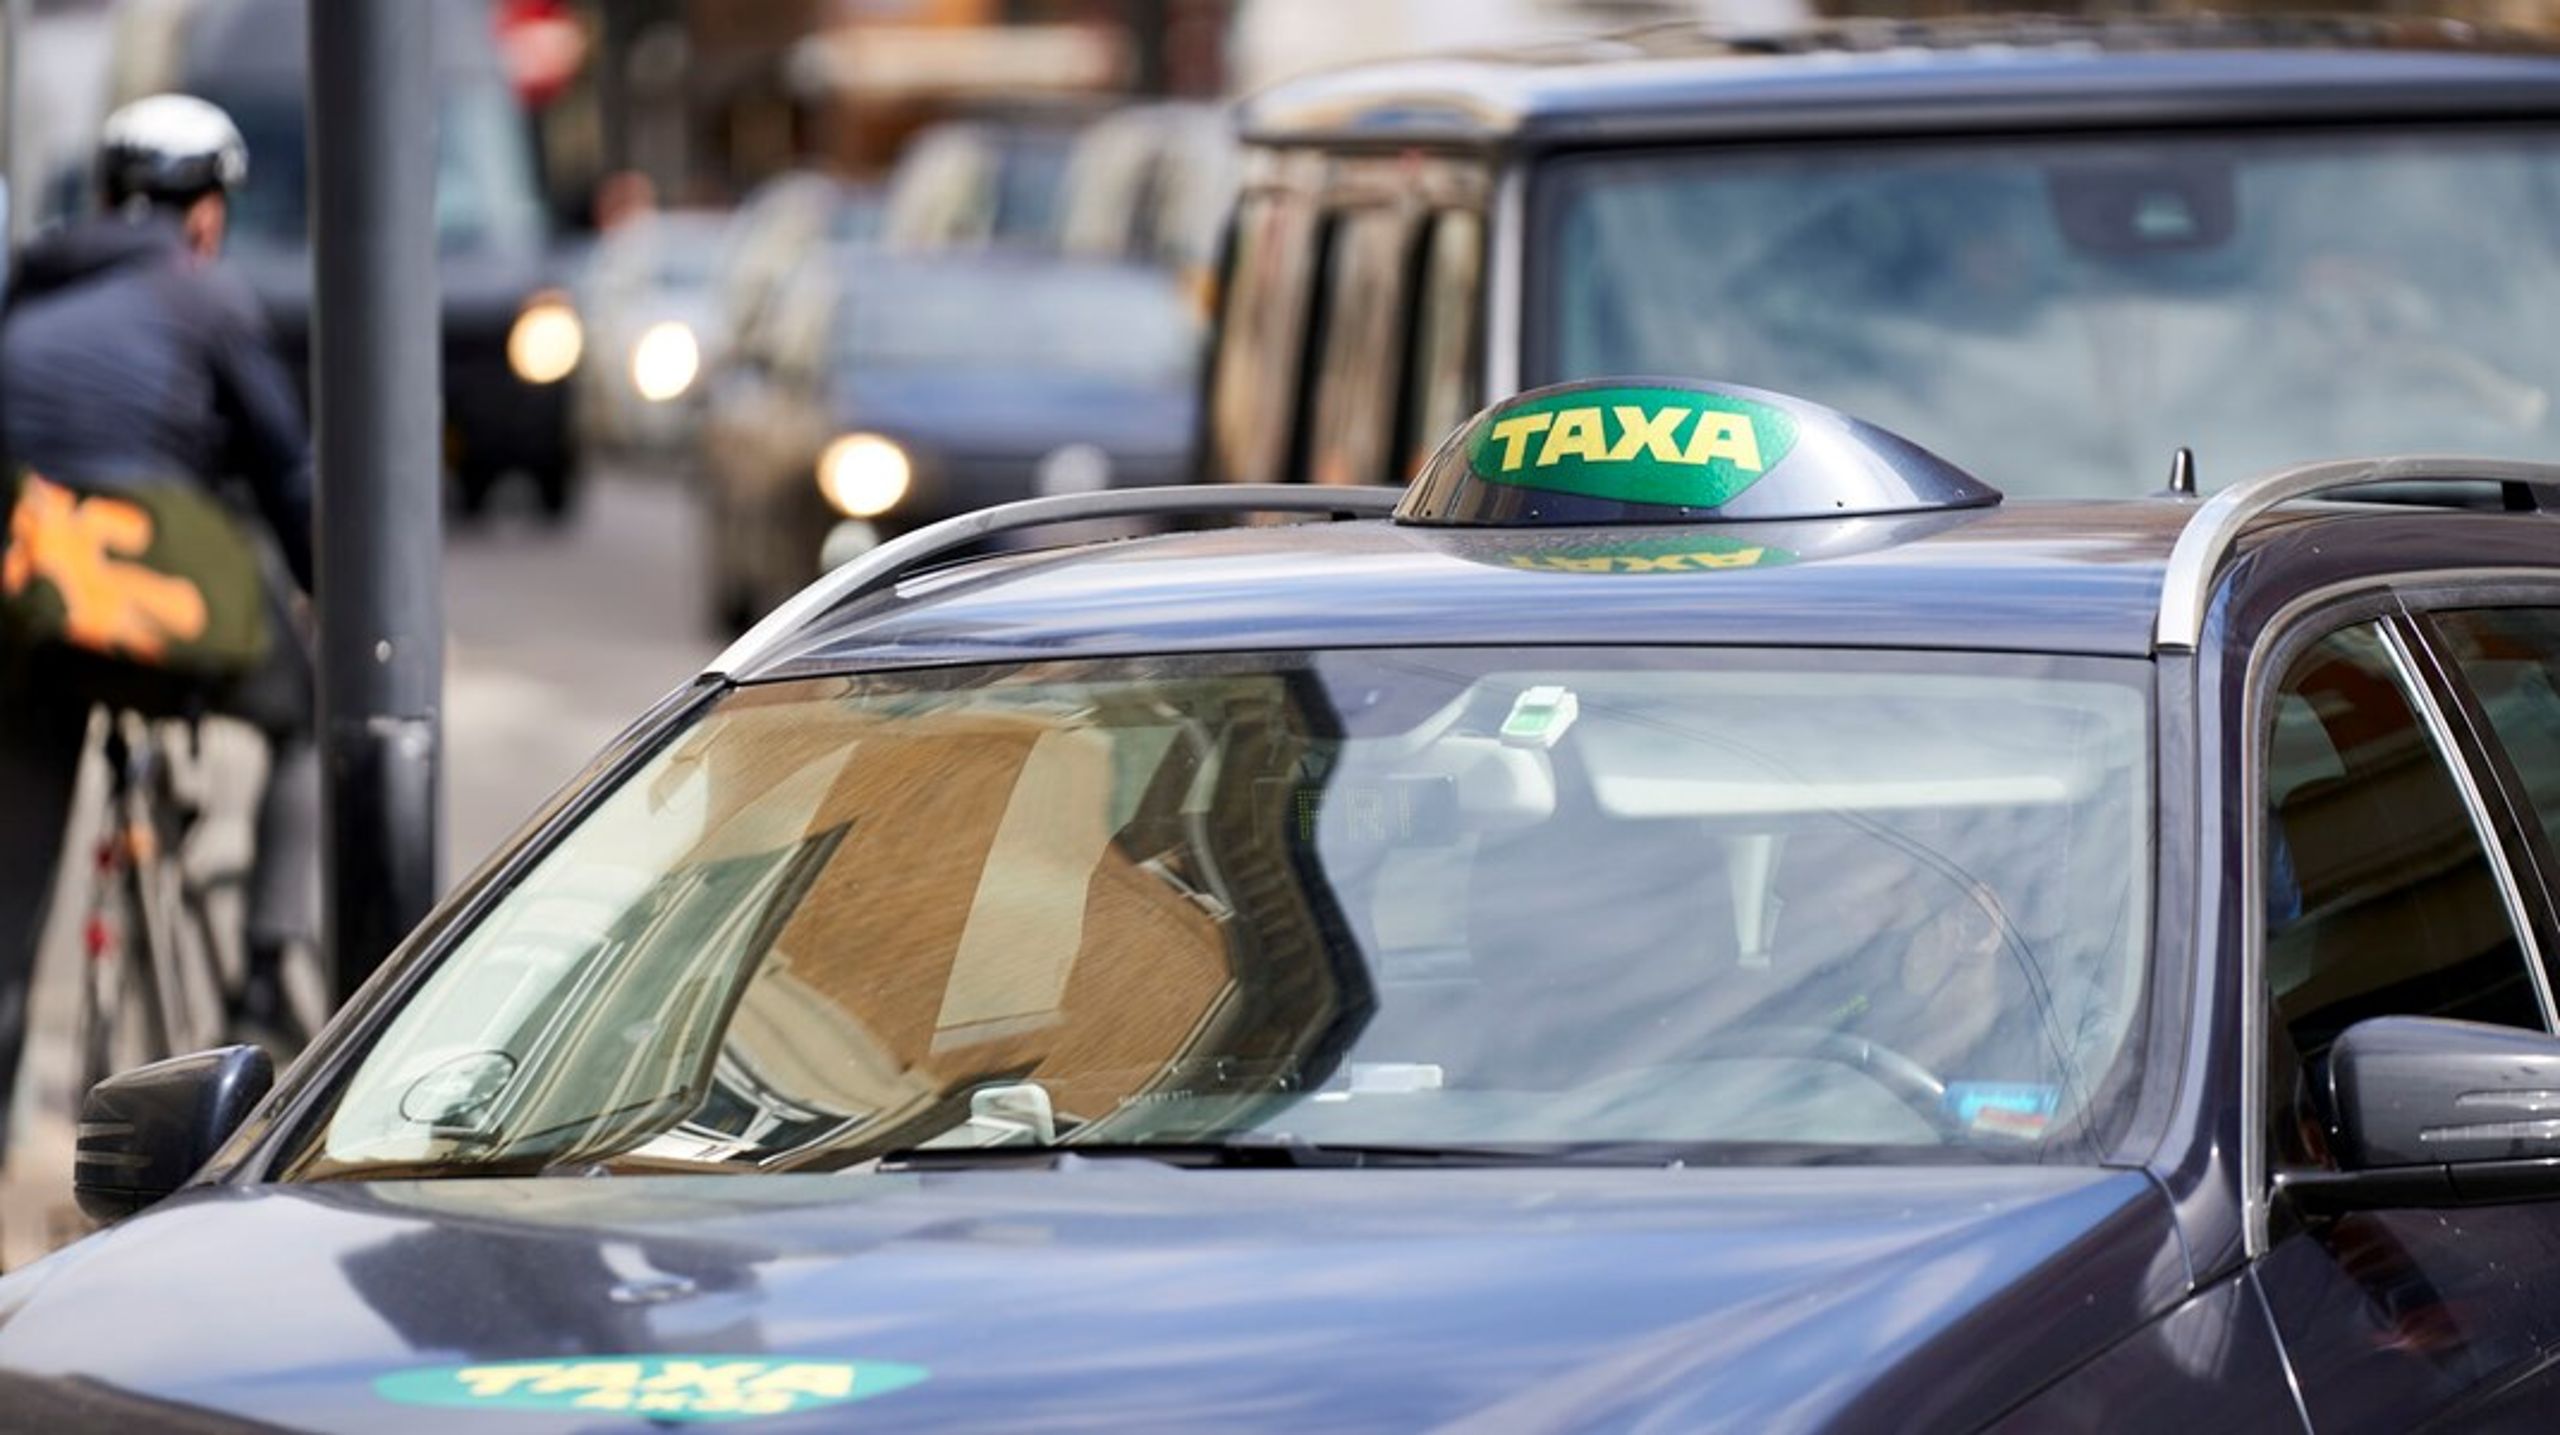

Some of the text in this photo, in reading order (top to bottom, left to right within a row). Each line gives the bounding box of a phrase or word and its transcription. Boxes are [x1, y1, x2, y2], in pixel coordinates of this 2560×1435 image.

[1491, 406, 1763, 472] TAXA
[1296, 786, 1413, 841] FRI
[456, 1362, 856, 1398] TAXA
